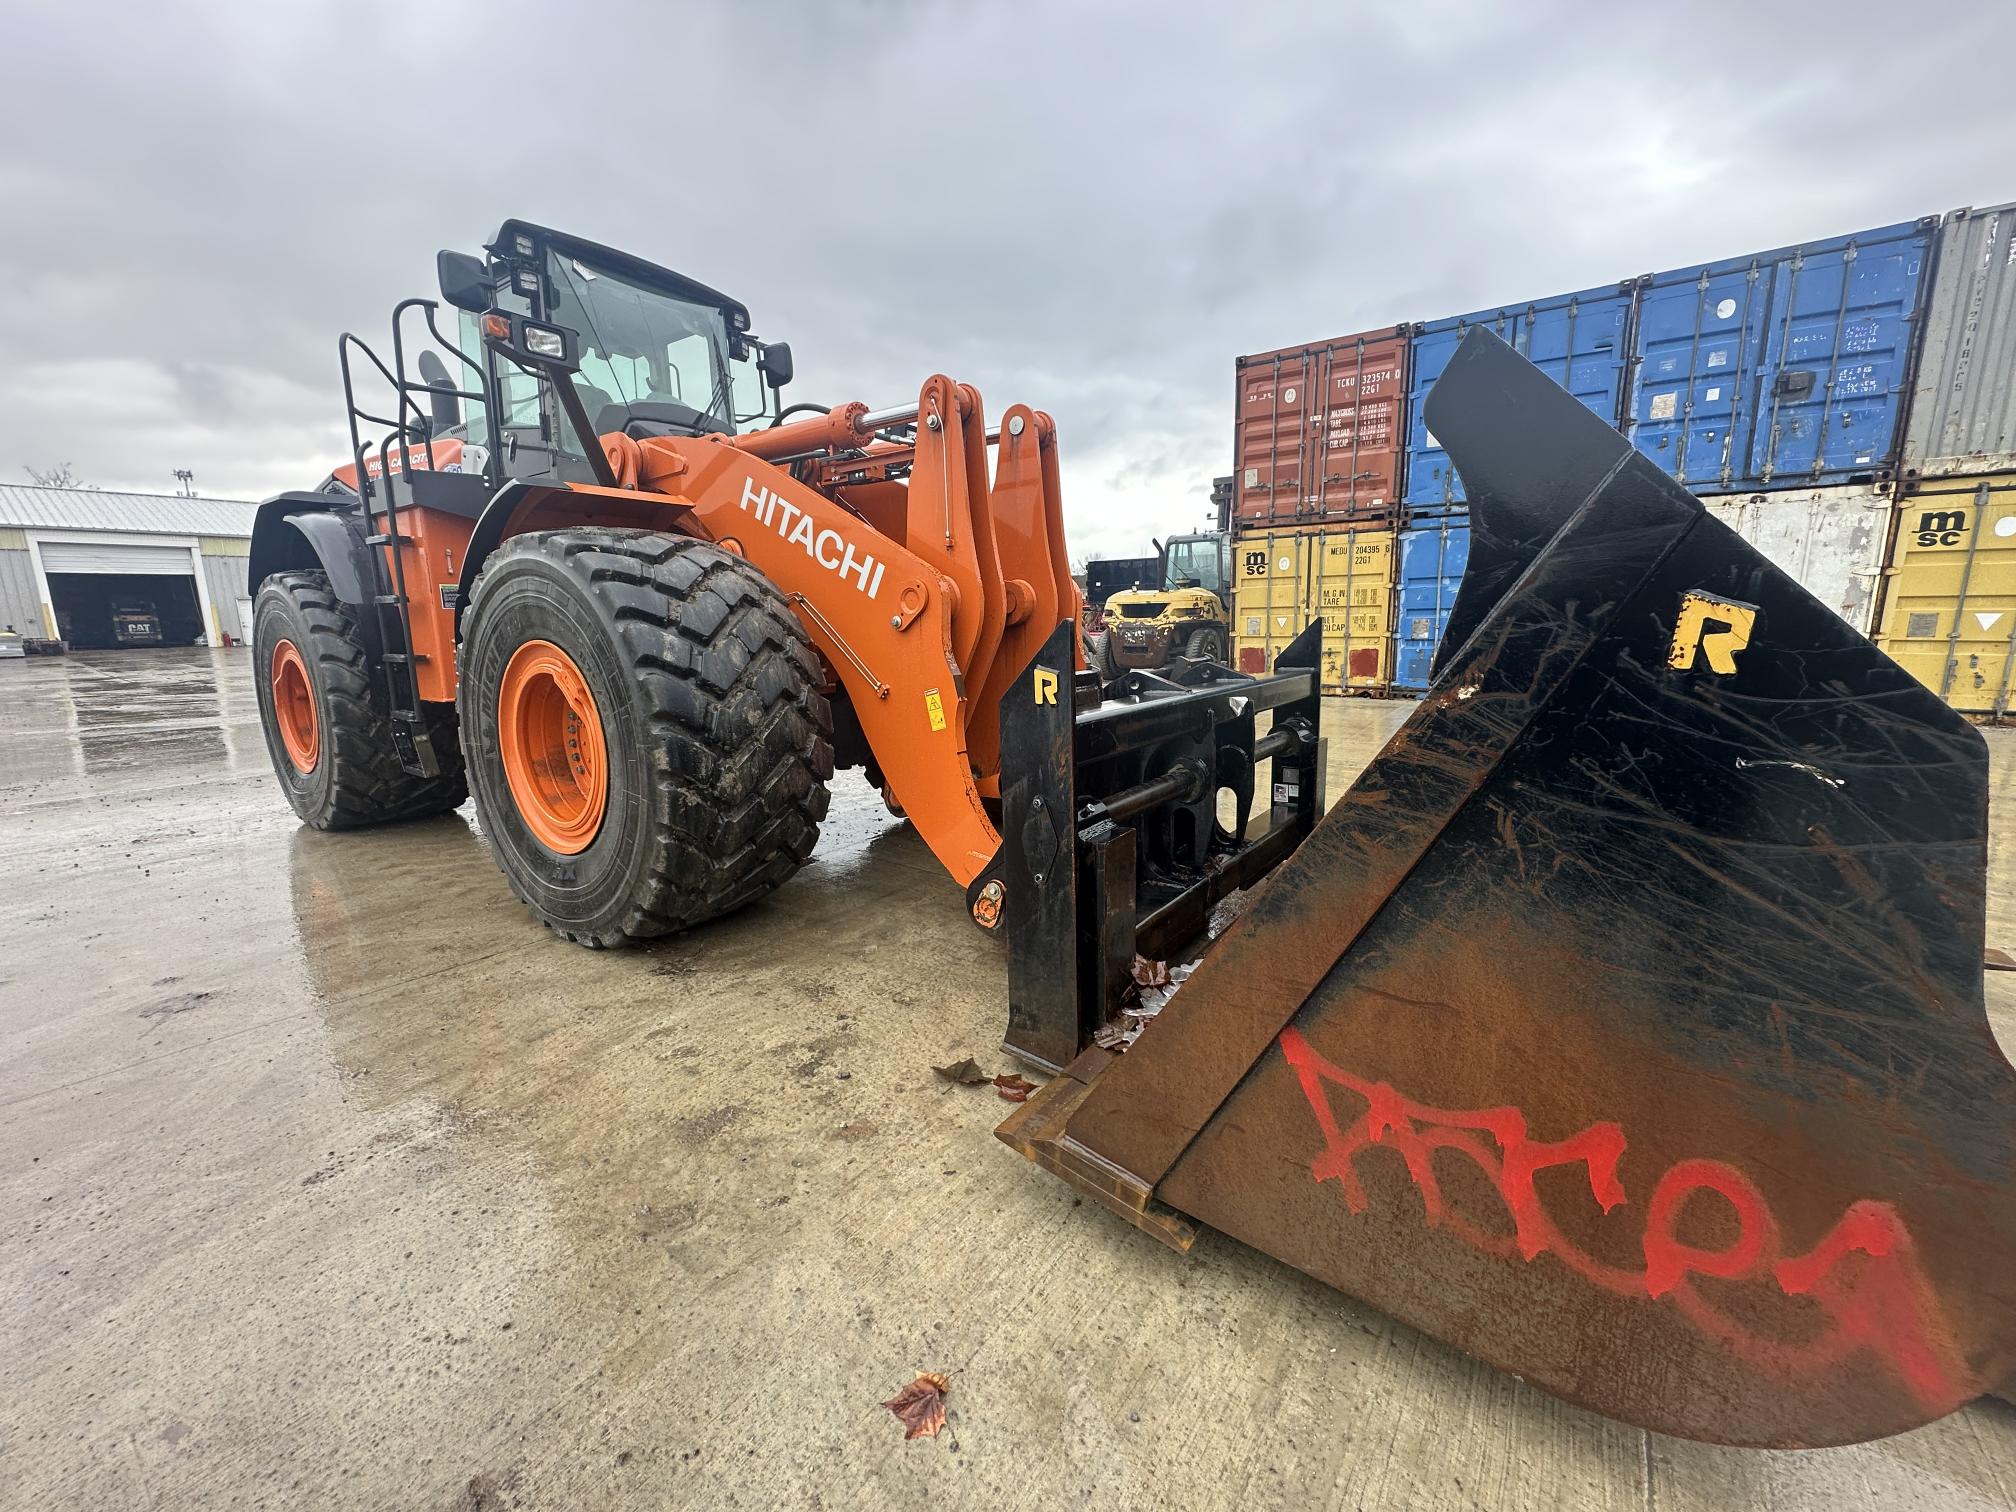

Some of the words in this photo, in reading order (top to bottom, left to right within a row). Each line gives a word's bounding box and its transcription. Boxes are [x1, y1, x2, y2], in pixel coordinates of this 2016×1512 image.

[1337, 377, 1355, 389] TCKU
[1362, 371, 1391, 384] 323574
[1361, 384, 1380, 395] 22G1
[740, 476, 885, 600] HITACHI
[1331, 547, 1348, 555] MEDU
[1355, 545, 1380, 554] 204395
[1355, 556, 1371, 565] 22G1
[1323, 598, 1340, 606] TARE
[128, 623, 151, 634] CAT
[1332, 623, 1346, 632] CAP
[1668, 592, 1755, 674] R
[1034, 667, 1058, 705] R
